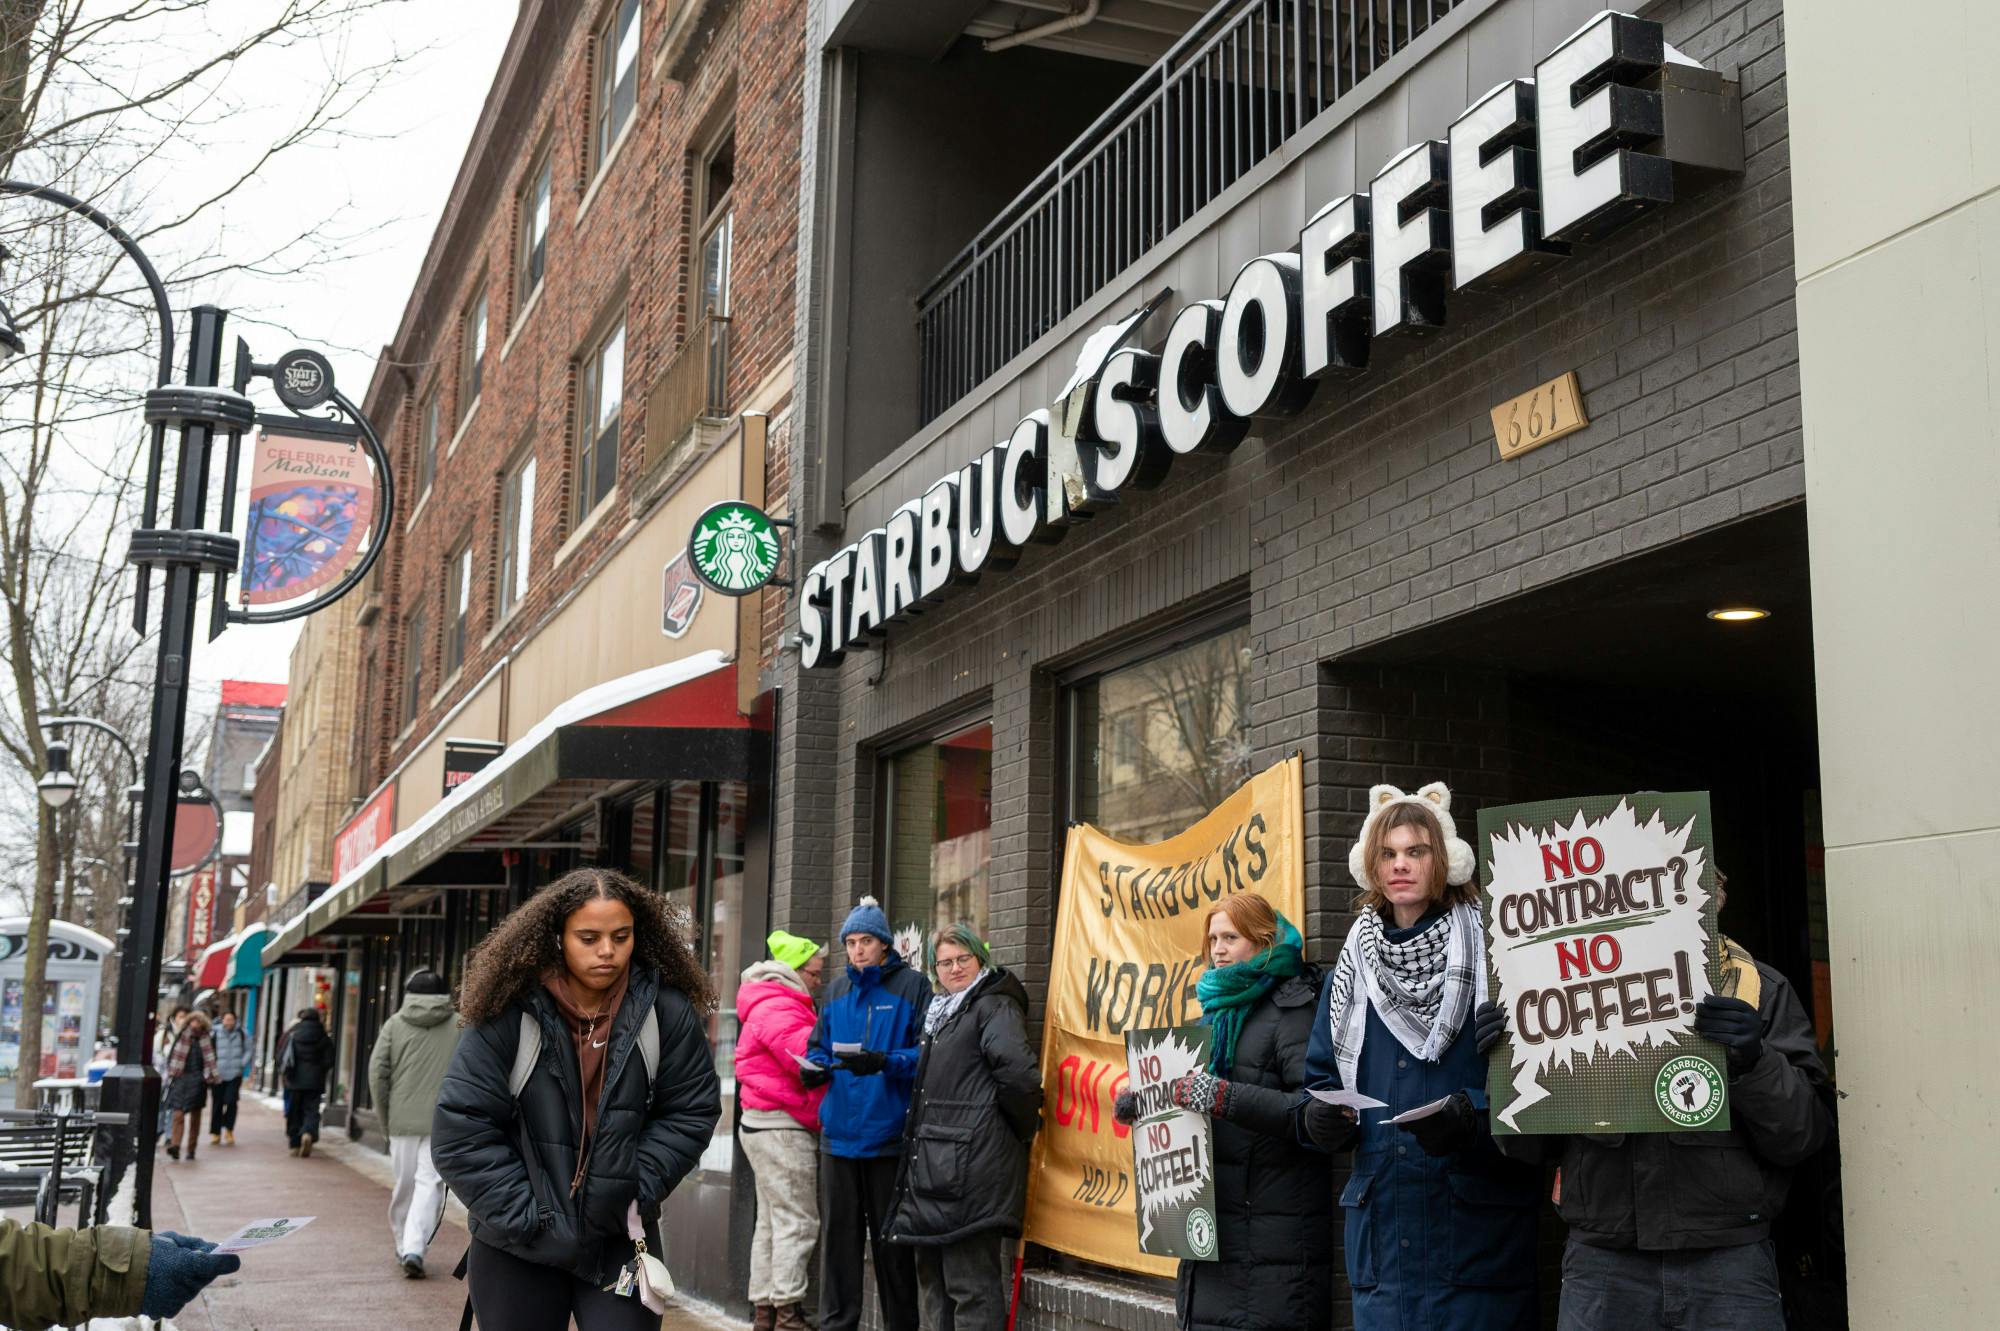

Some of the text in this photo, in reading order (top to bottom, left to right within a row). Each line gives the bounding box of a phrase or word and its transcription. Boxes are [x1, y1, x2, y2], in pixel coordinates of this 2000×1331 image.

[800, 12, 1625, 670] STARBUCKS COFFEE
[285, 366, 318, 381] STATE
[1507, 384, 1556, 448] 661
[263, 457, 350, 478] Madison
[267, 448, 355, 468] CELEBRATE
[1099, 813, 1268, 920] STARBUCKS
[1539, 836, 1604, 882] NO
[1499, 856, 1689, 937] CONTRACT?
[1555, 934, 1622, 981] NO
[1086, 957, 1203, 1035] WORKE
[1516, 950, 1694, 1045] COFFEE!
[1138, 1055, 1162, 1085] NO
[1663, 1060, 1715, 1079] STARBUCKS
[1056, 1056, 1111, 1134] ON
[1660, 1089, 1721, 1122] WORKERS UNITED
[1147, 1122, 1171, 1153] NO
[1073, 1164, 1129, 1208] HOLD
[1140, 1135, 1203, 1196] COFFEE!
